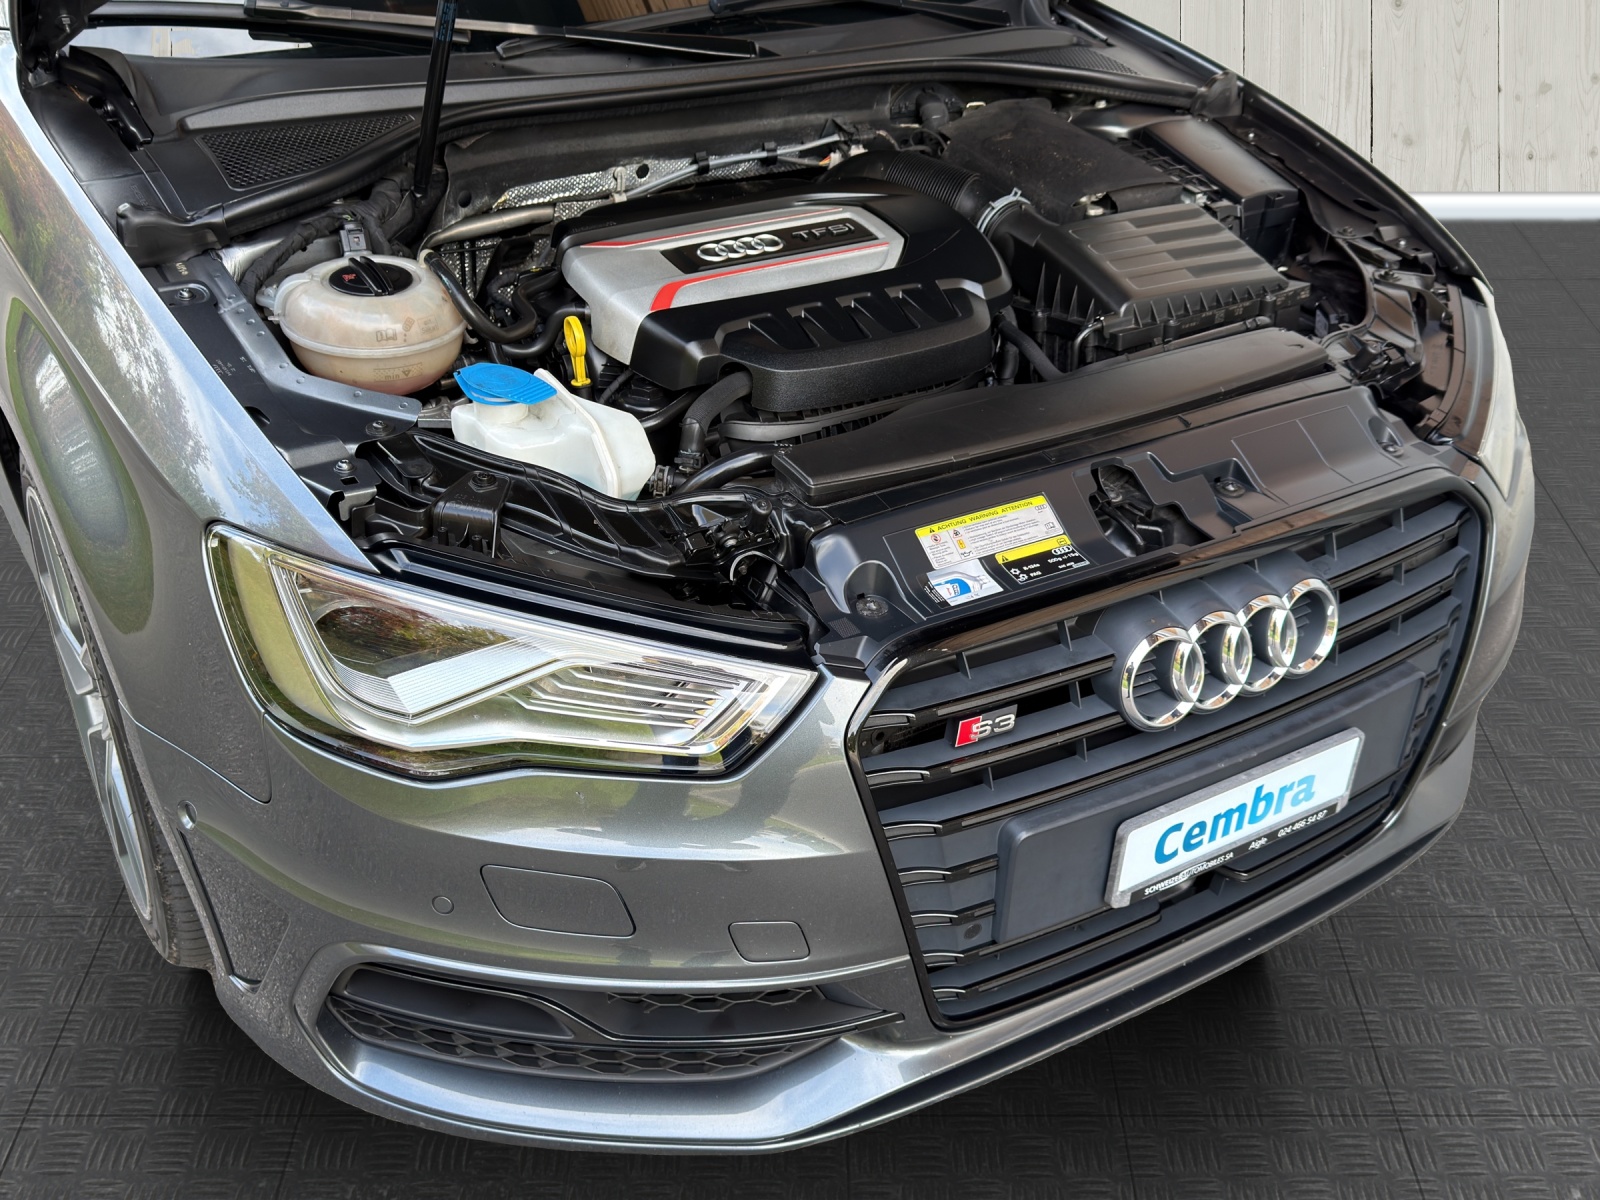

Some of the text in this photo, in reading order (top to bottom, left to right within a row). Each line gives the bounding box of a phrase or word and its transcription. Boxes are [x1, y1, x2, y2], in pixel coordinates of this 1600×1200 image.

[791, 222, 855, 239] TFSI
[937, 501, 1033, 531] ACHTUNG WARNING ATTENTION
[969, 713, 1015, 740] S3
[1154, 774, 1316, 864] Cembra
[1248, 809, 1328, 850] Aigle 024 466 54 87
